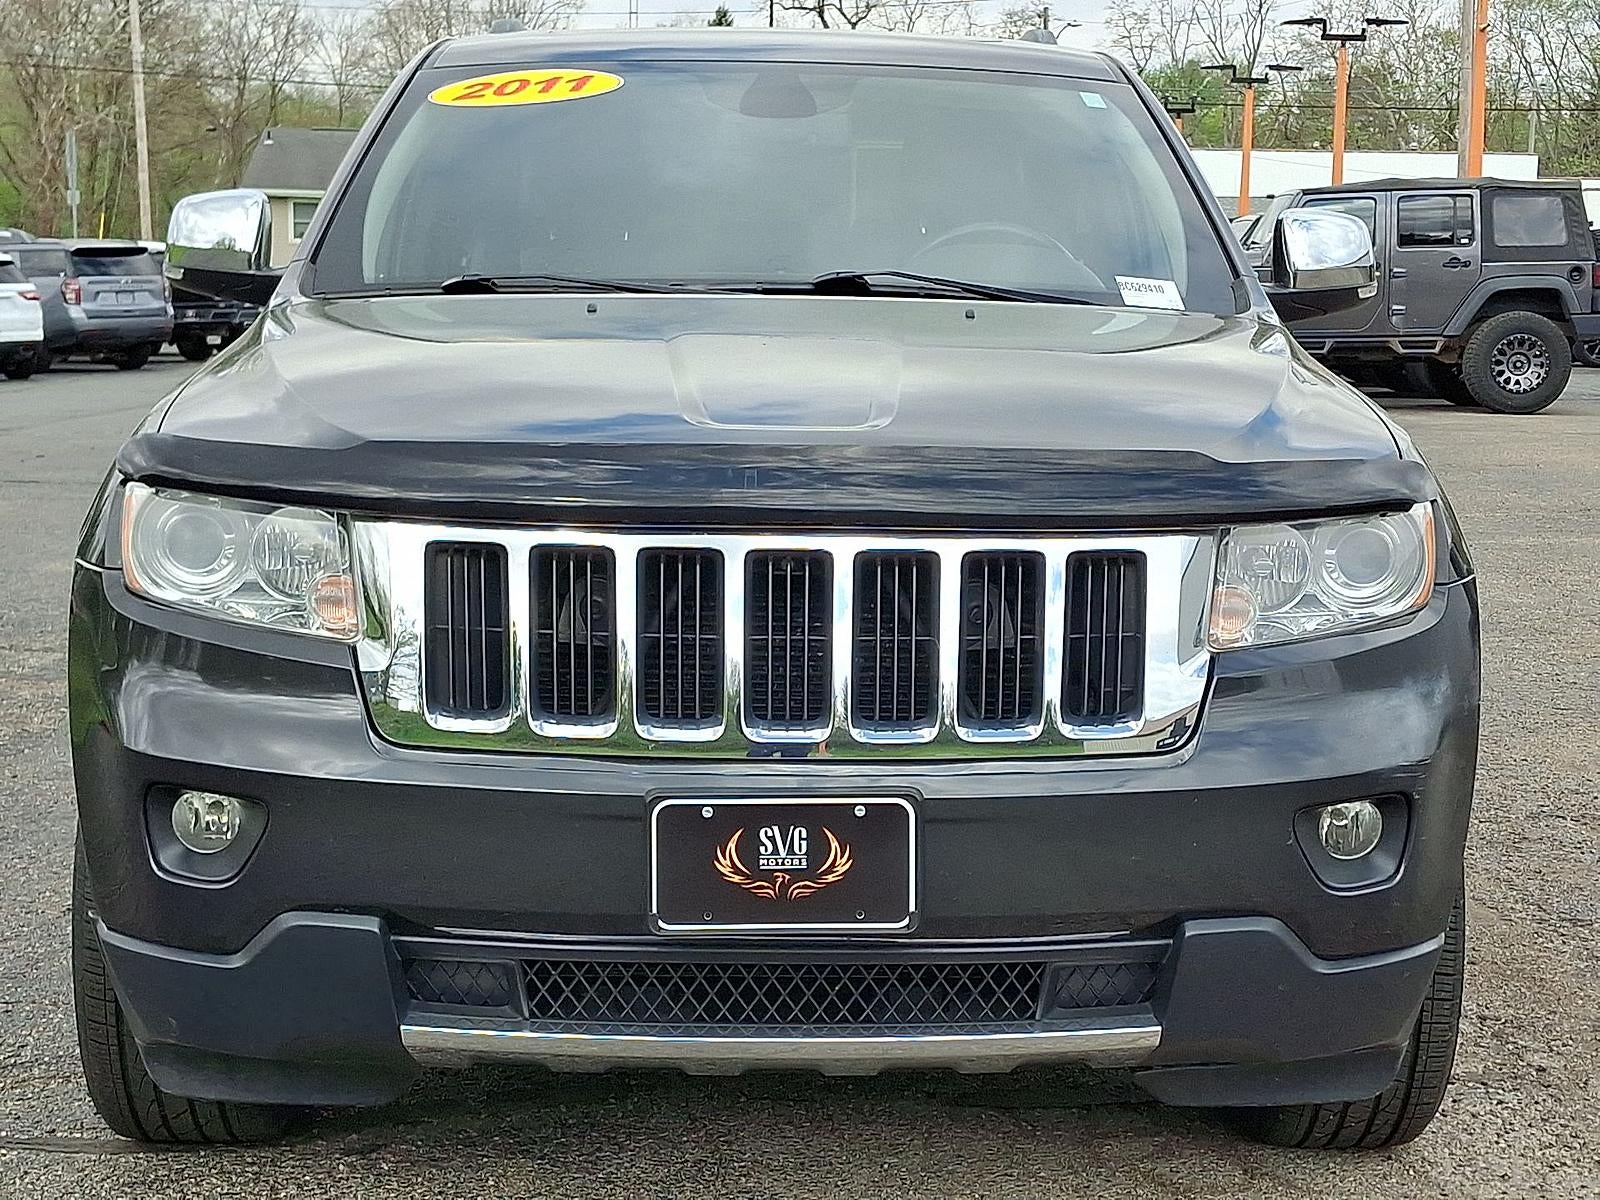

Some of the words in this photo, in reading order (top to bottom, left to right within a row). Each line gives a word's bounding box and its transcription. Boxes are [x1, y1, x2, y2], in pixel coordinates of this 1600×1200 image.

[452, 75, 594, 101] 2011
[759, 825, 807, 857] SVG
[759, 858, 807, 866] MOTORS
